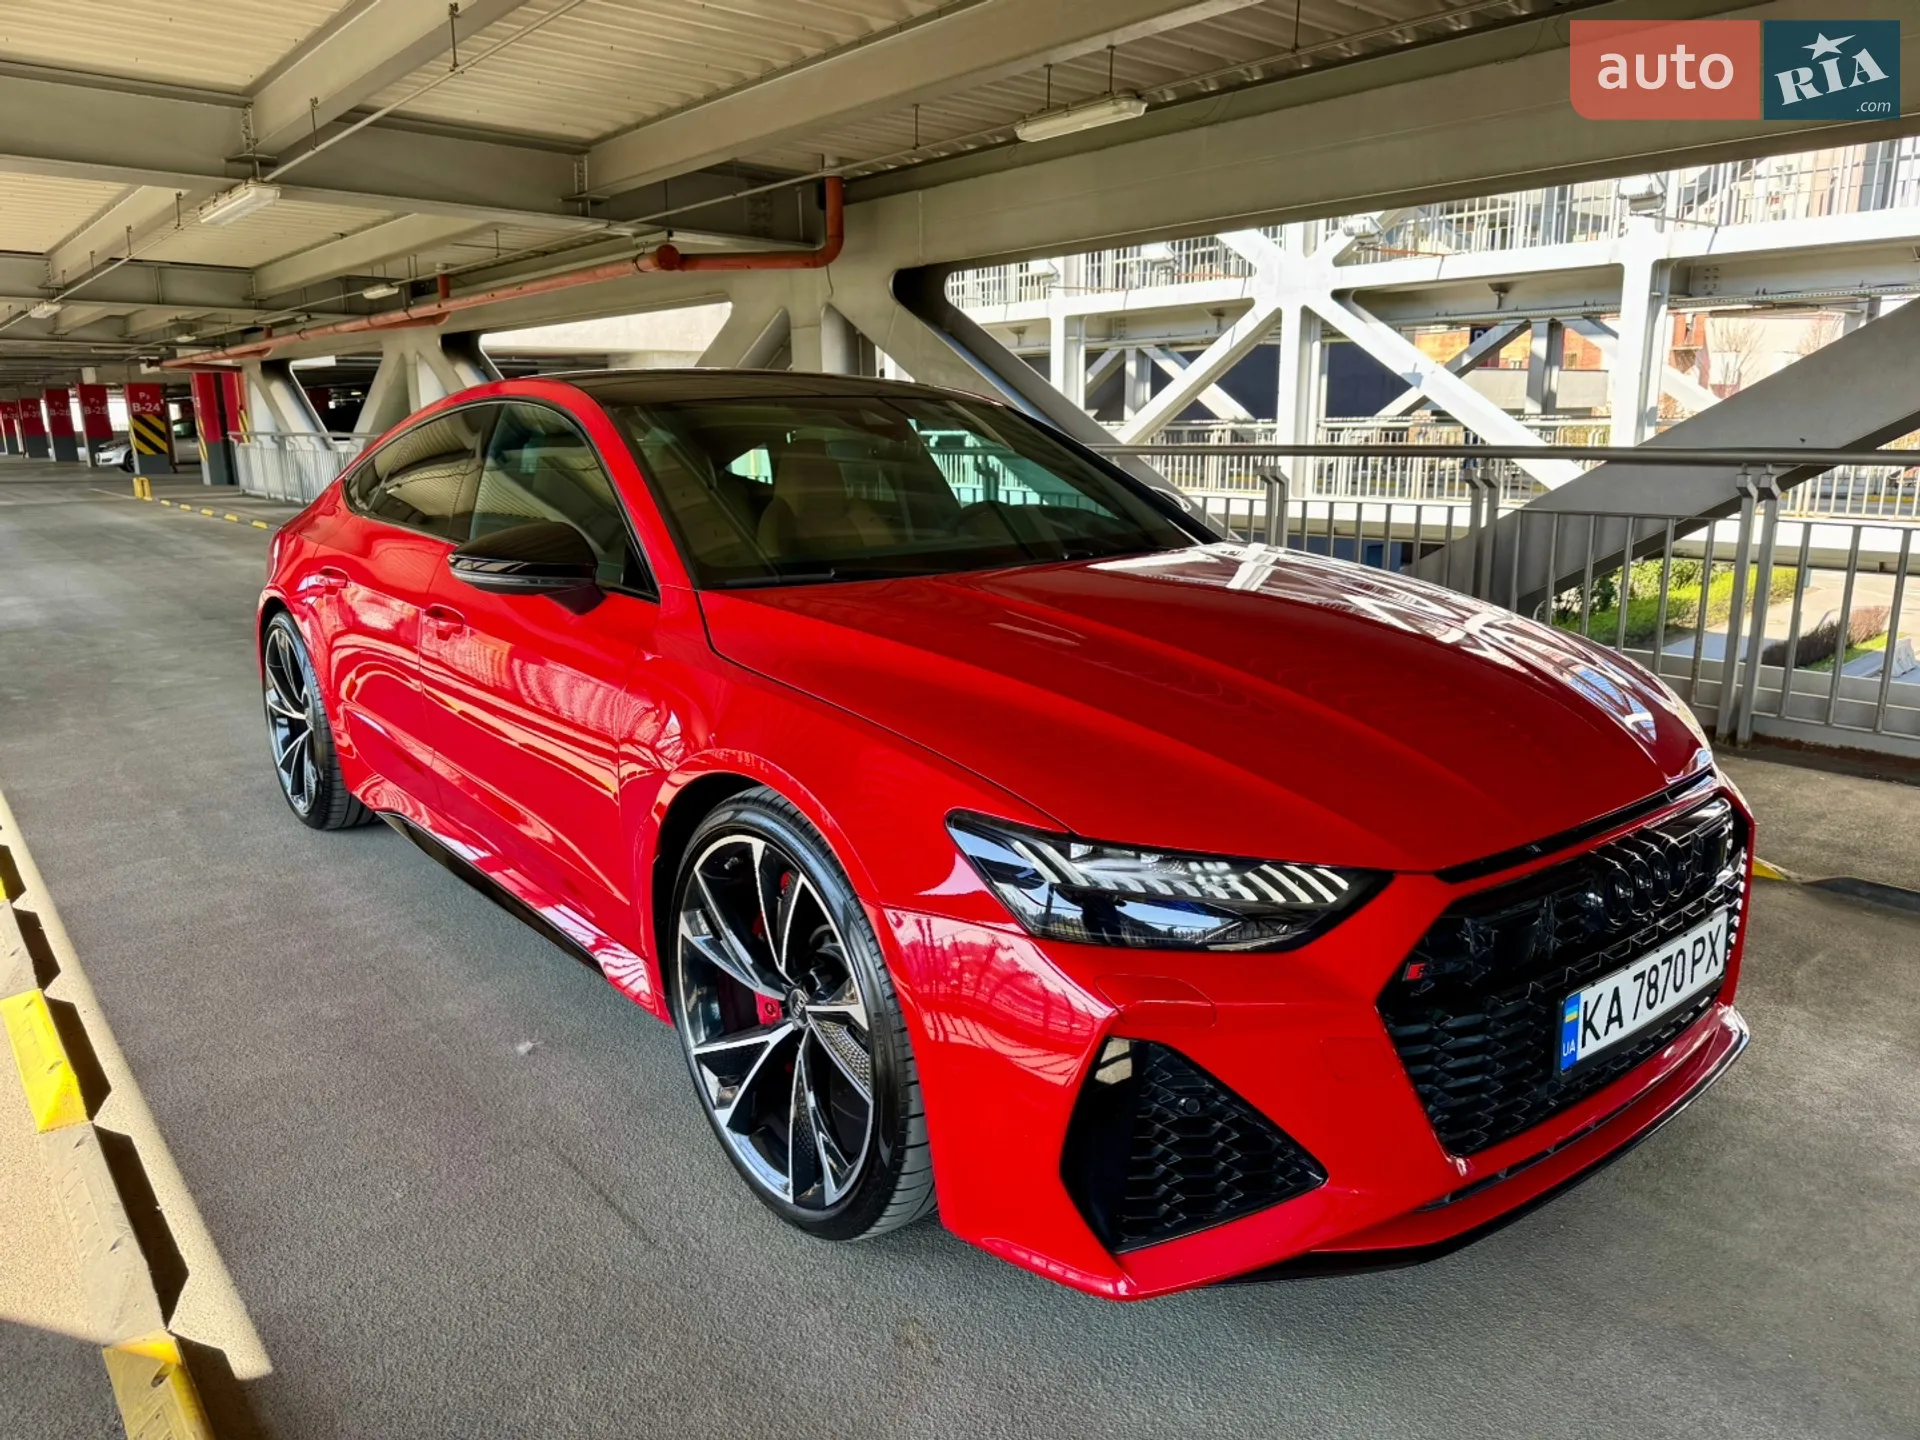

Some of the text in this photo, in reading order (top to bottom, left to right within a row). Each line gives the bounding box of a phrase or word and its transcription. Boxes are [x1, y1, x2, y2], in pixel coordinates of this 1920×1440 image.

[1581, 924, 1722, 1049] KA 7870 PX
[1562, 1043, 1576, 1057] UA
